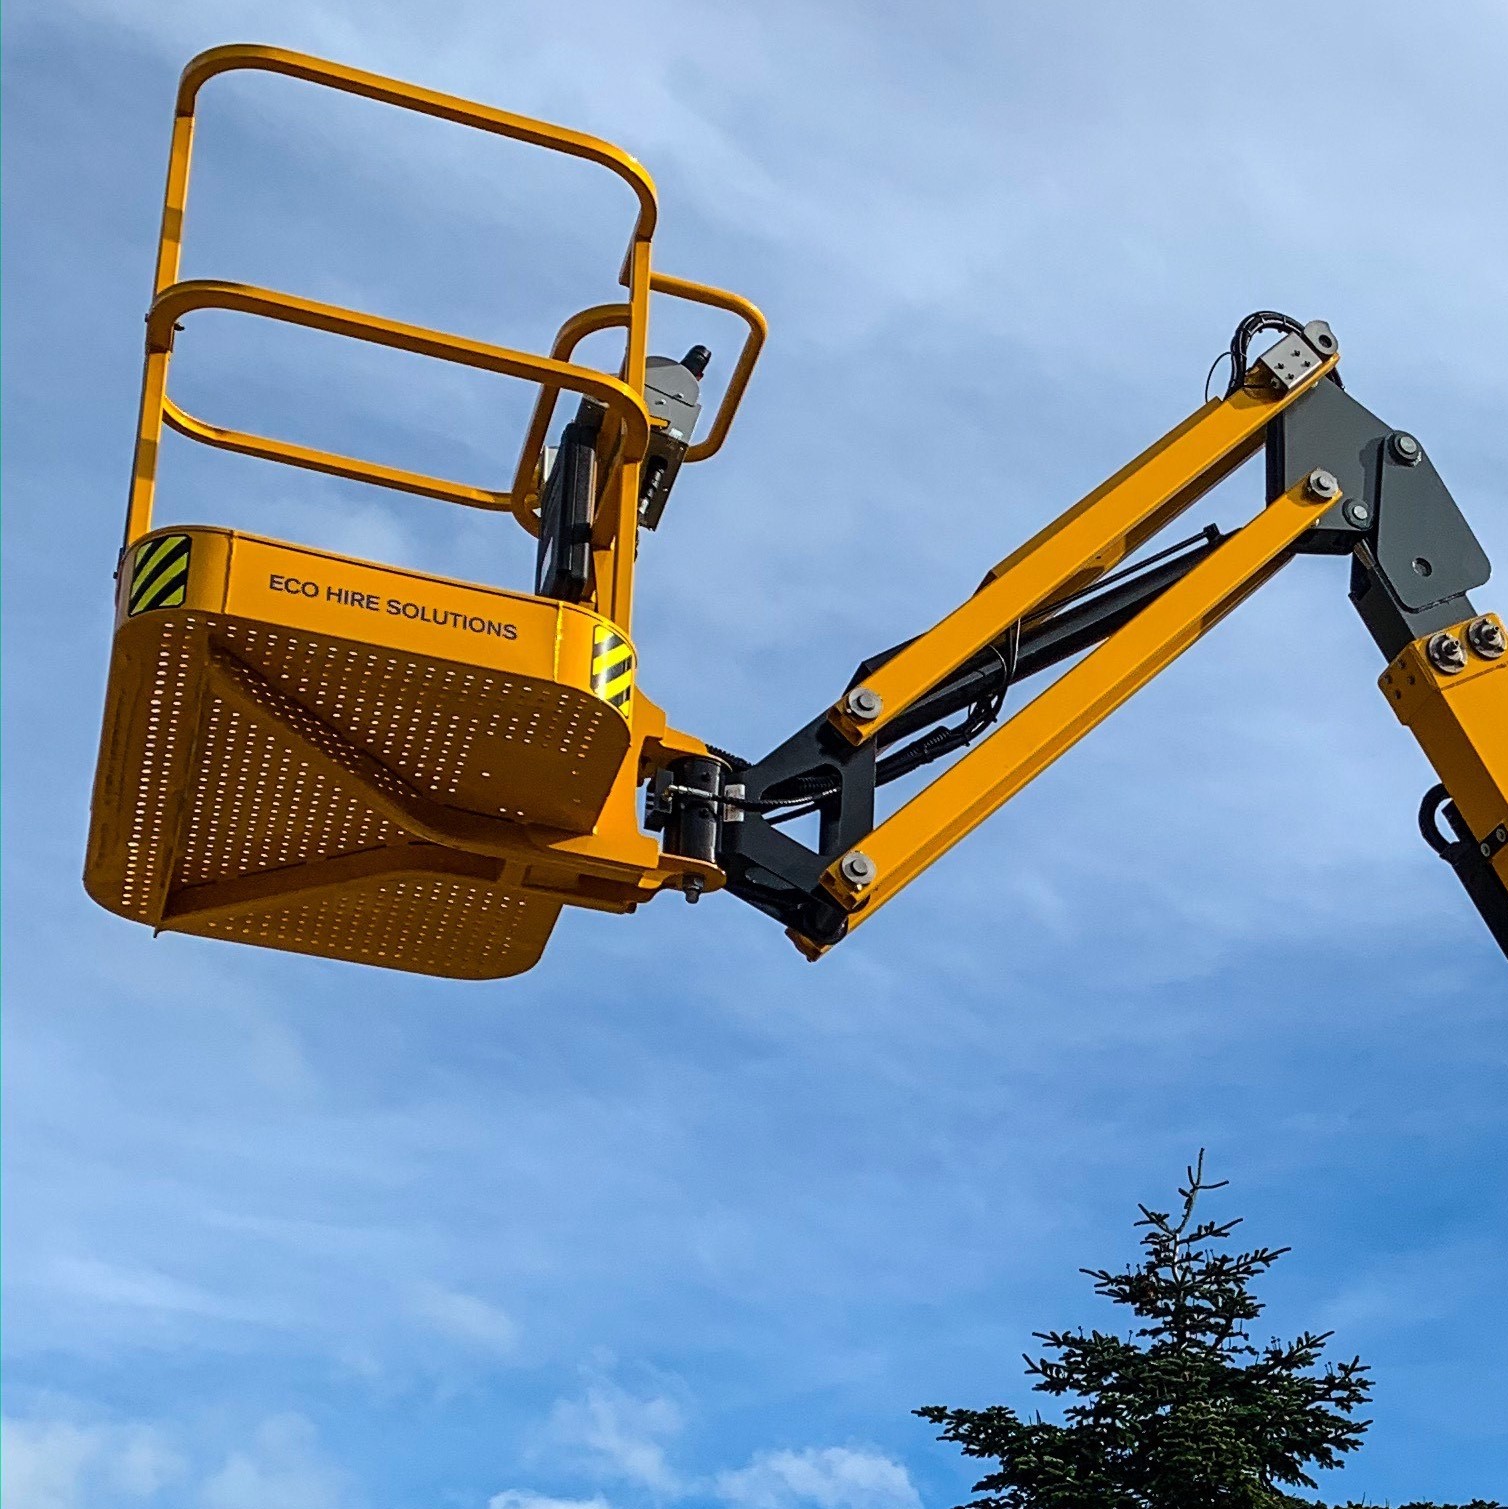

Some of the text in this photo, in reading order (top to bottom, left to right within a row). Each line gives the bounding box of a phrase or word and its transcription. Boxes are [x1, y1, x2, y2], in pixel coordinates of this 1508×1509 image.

[269, 573, 519, 641] ECO HIRE SOLUTIONS
